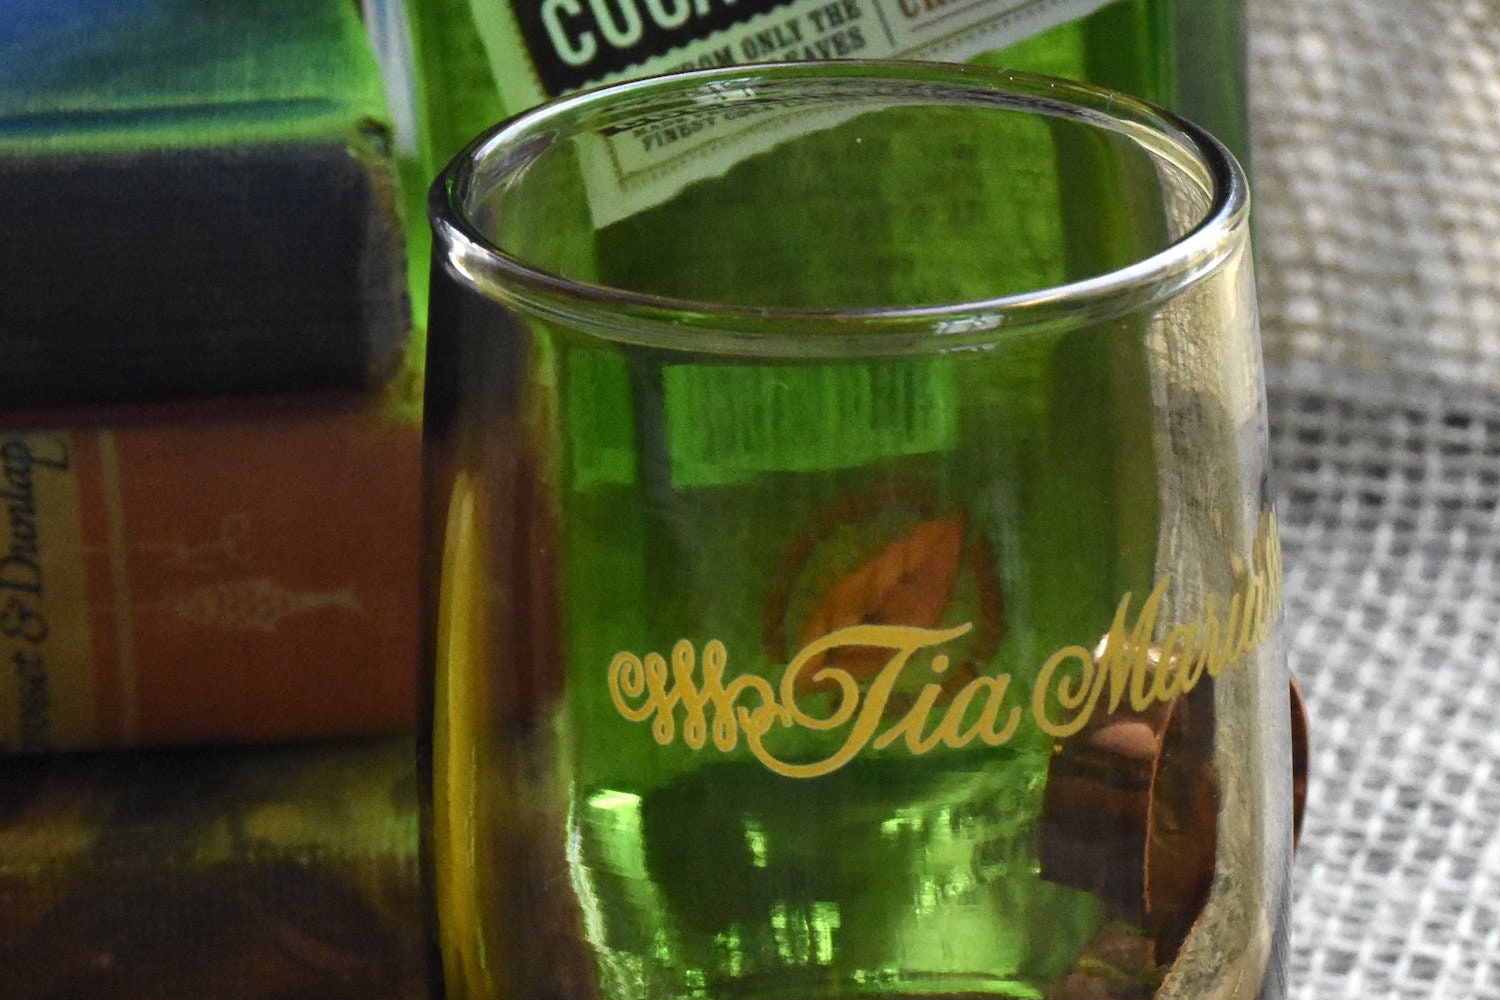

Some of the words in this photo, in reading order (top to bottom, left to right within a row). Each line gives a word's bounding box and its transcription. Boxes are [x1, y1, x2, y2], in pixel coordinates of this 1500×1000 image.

[740, 18, 802, 60] ONLY
[807, 0, 862, 32] THE
[745, 621, 1021, 779] Tia
